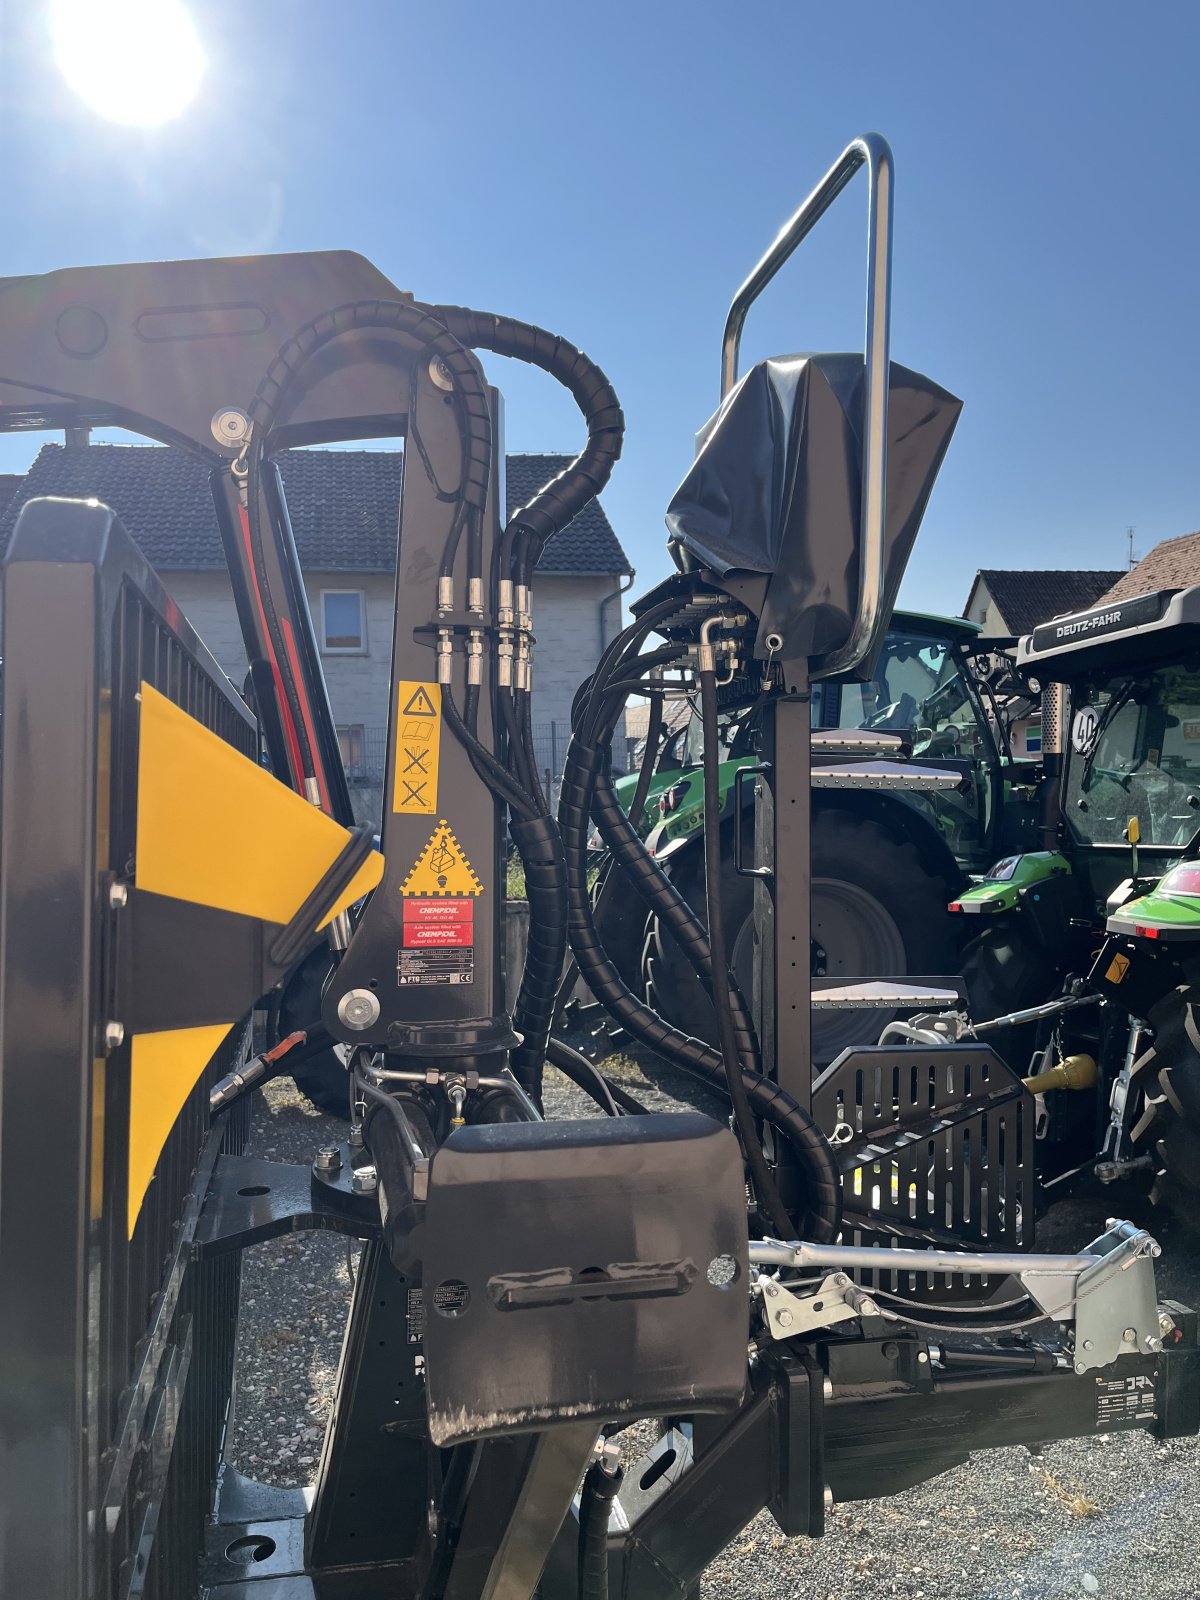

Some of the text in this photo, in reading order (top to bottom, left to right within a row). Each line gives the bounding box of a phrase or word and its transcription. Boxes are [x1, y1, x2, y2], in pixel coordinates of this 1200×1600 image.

[1056, 611, 1121, 638] DEUTZ-FAHR
[1077, 714, 1095, 743] 40
[460, 974, 471, 982] CE
